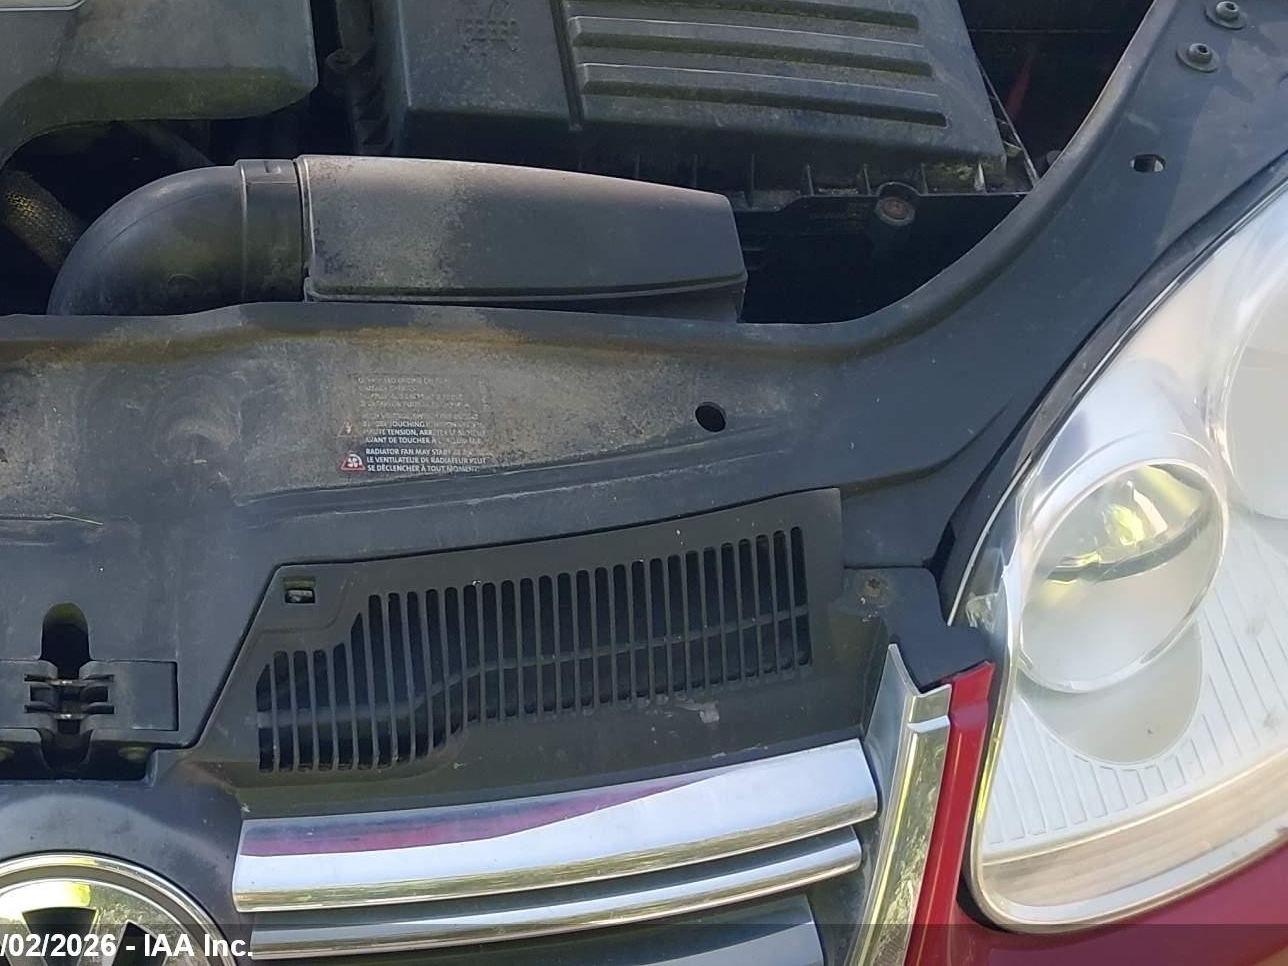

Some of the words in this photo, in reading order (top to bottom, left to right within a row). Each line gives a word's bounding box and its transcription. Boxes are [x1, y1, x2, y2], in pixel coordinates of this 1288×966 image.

[388, 436, 398, 444] DE
[398, 436, 430, 444] TOUCHER
[367, 464, 376, 472] SE
[376, 463, 420, 472] DÉCLENCHER
[427, 464, 447, 472] TOUT
